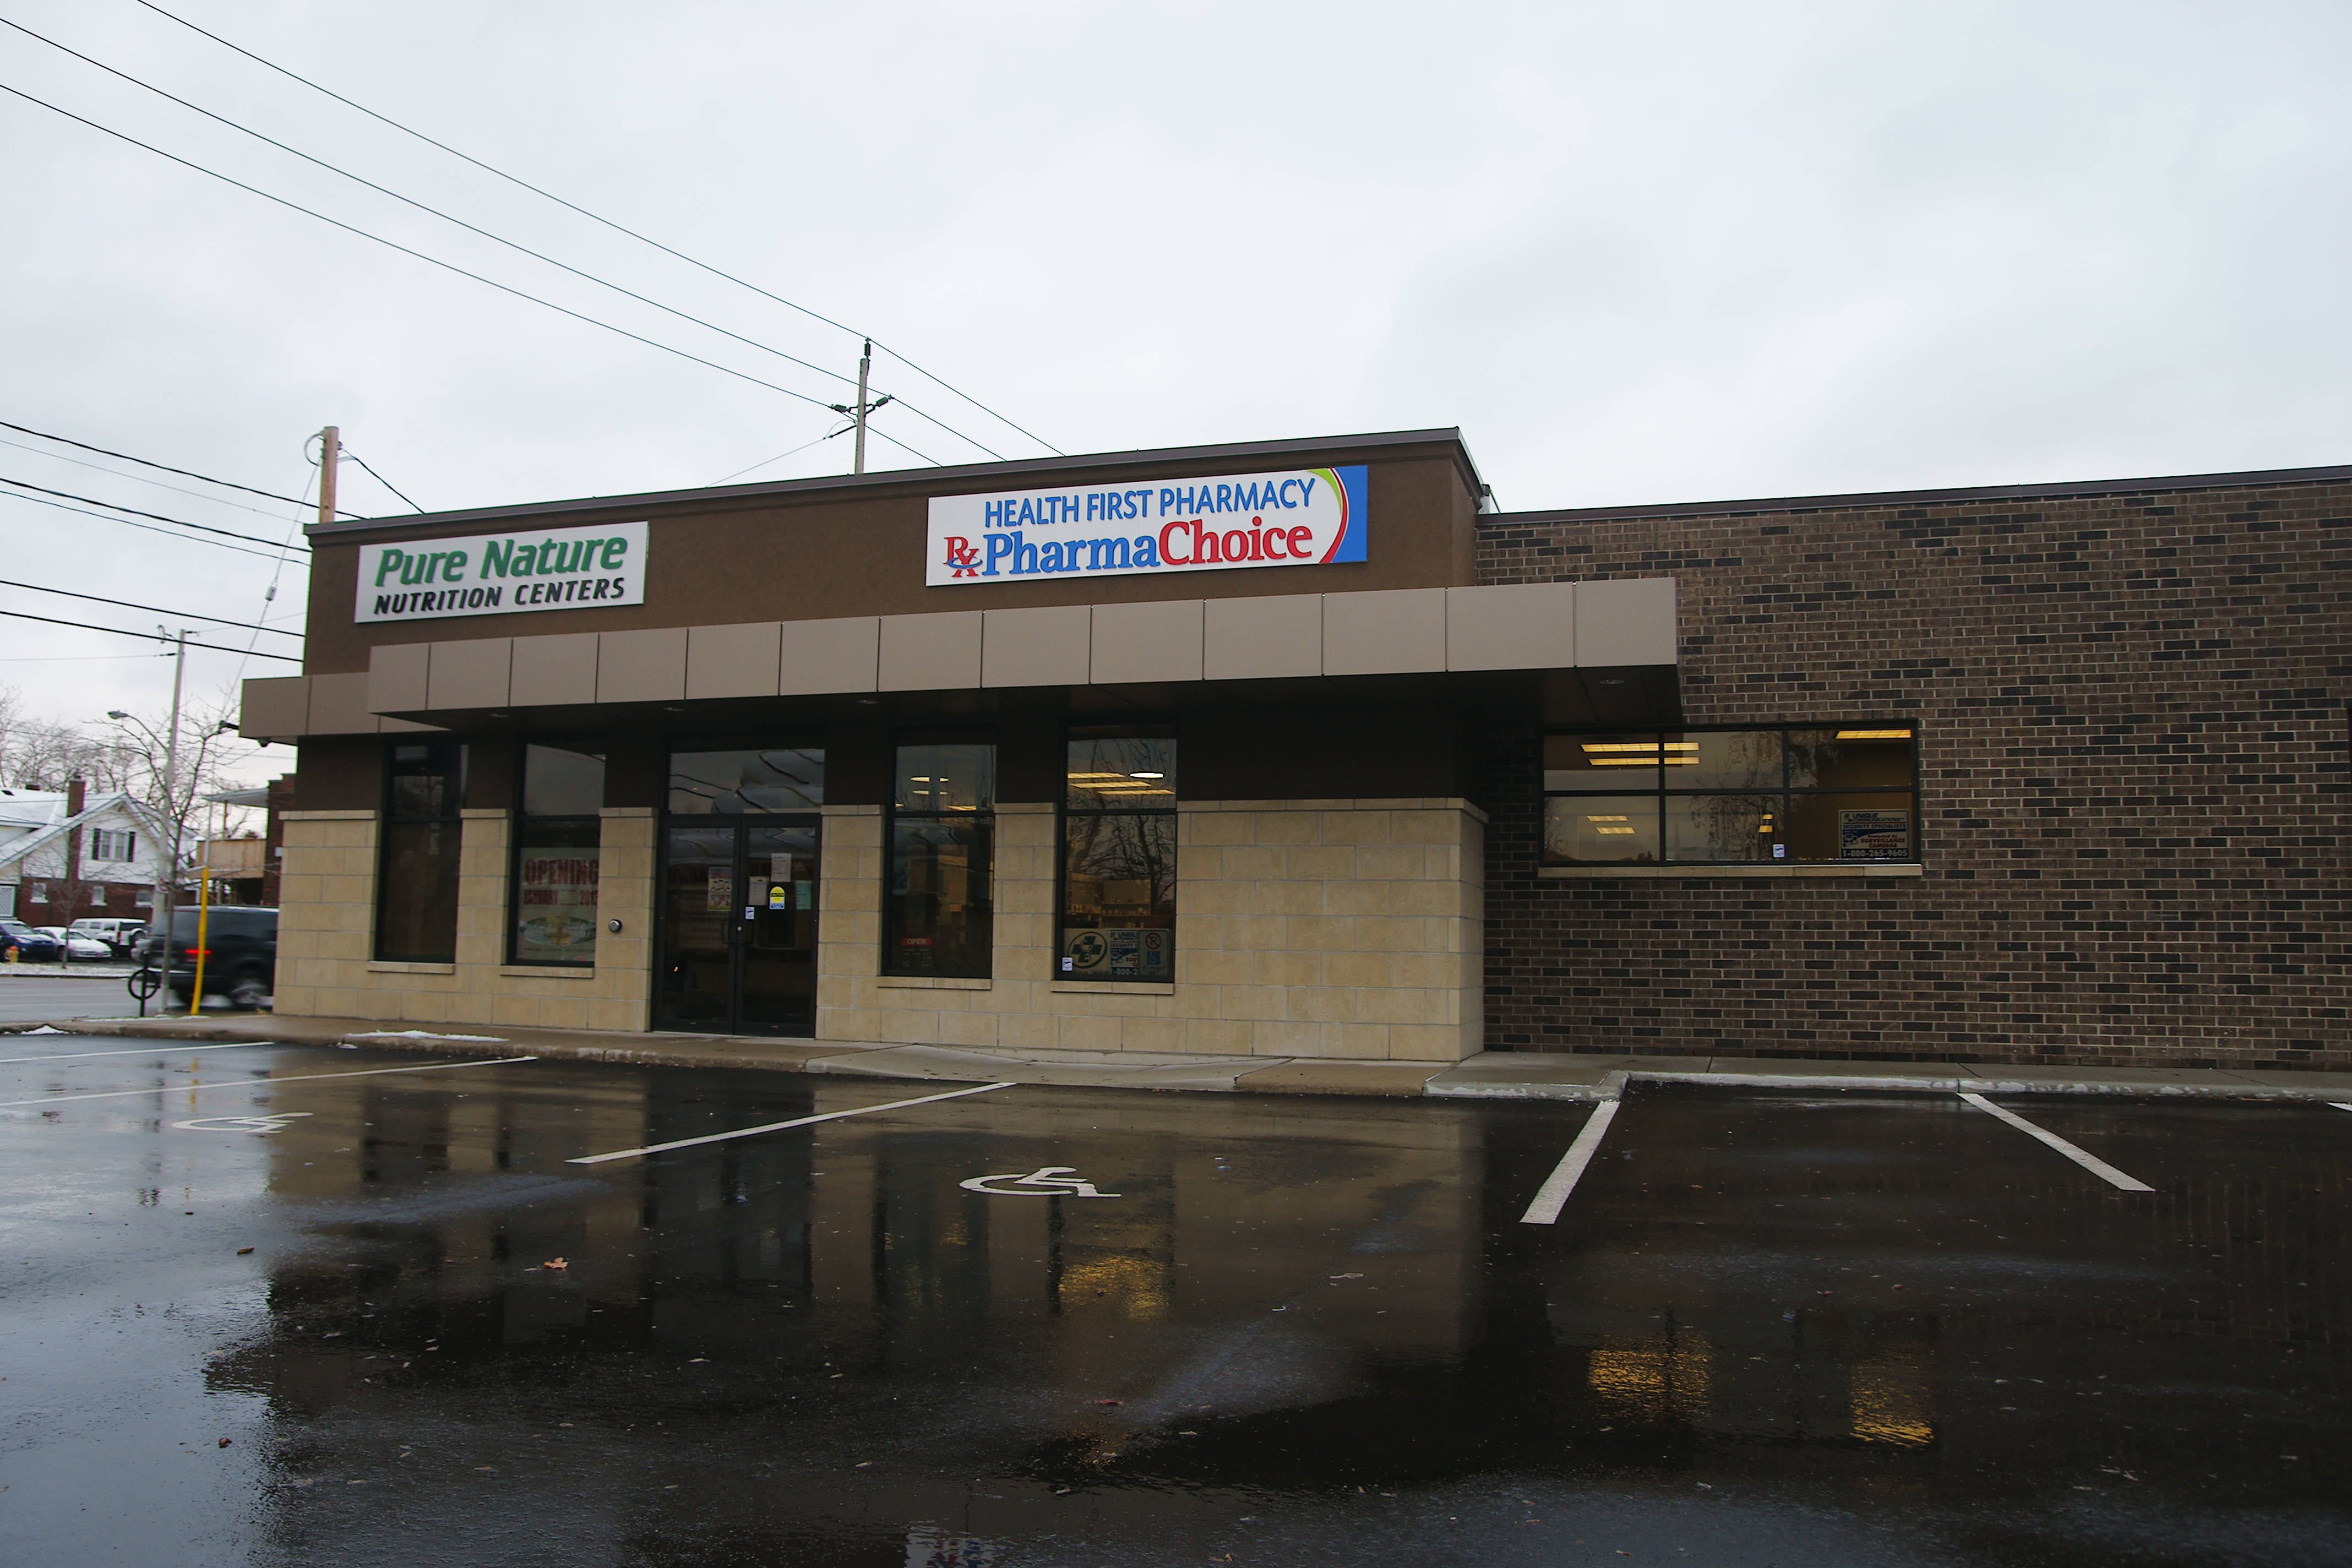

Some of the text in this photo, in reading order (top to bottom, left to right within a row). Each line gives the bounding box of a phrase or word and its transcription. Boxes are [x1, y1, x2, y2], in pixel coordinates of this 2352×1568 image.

[985, 477, 1316, 528] HEALTH FIRST PHARMACY
[374, 536, 628, 587] Pure Nature
[982, 515, 1313, 576] PharmaChoice
[373, 576, 625, 615] NUTRITION CENTERS
[525, 859, 599, 884] OPENING
